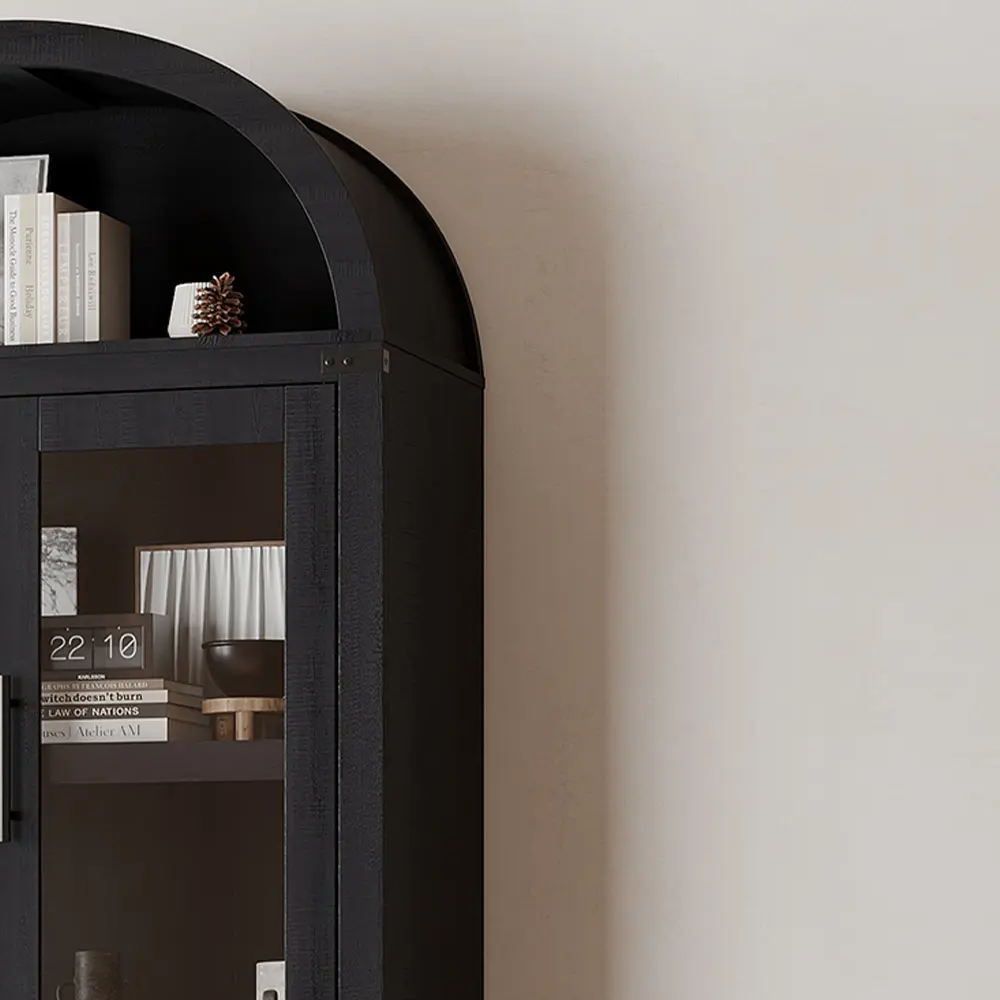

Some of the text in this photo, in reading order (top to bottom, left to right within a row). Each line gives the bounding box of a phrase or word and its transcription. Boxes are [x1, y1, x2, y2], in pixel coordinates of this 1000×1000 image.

[72, 692, 115, 702] doesn't
[116, 692, 142, 701] burn
[48, 708, 72, 718] LAW
[74, 708, 88, 717] OF
[92, 706, 140, 716] NATIONS
[77, 724, 115, 738] Atelier
